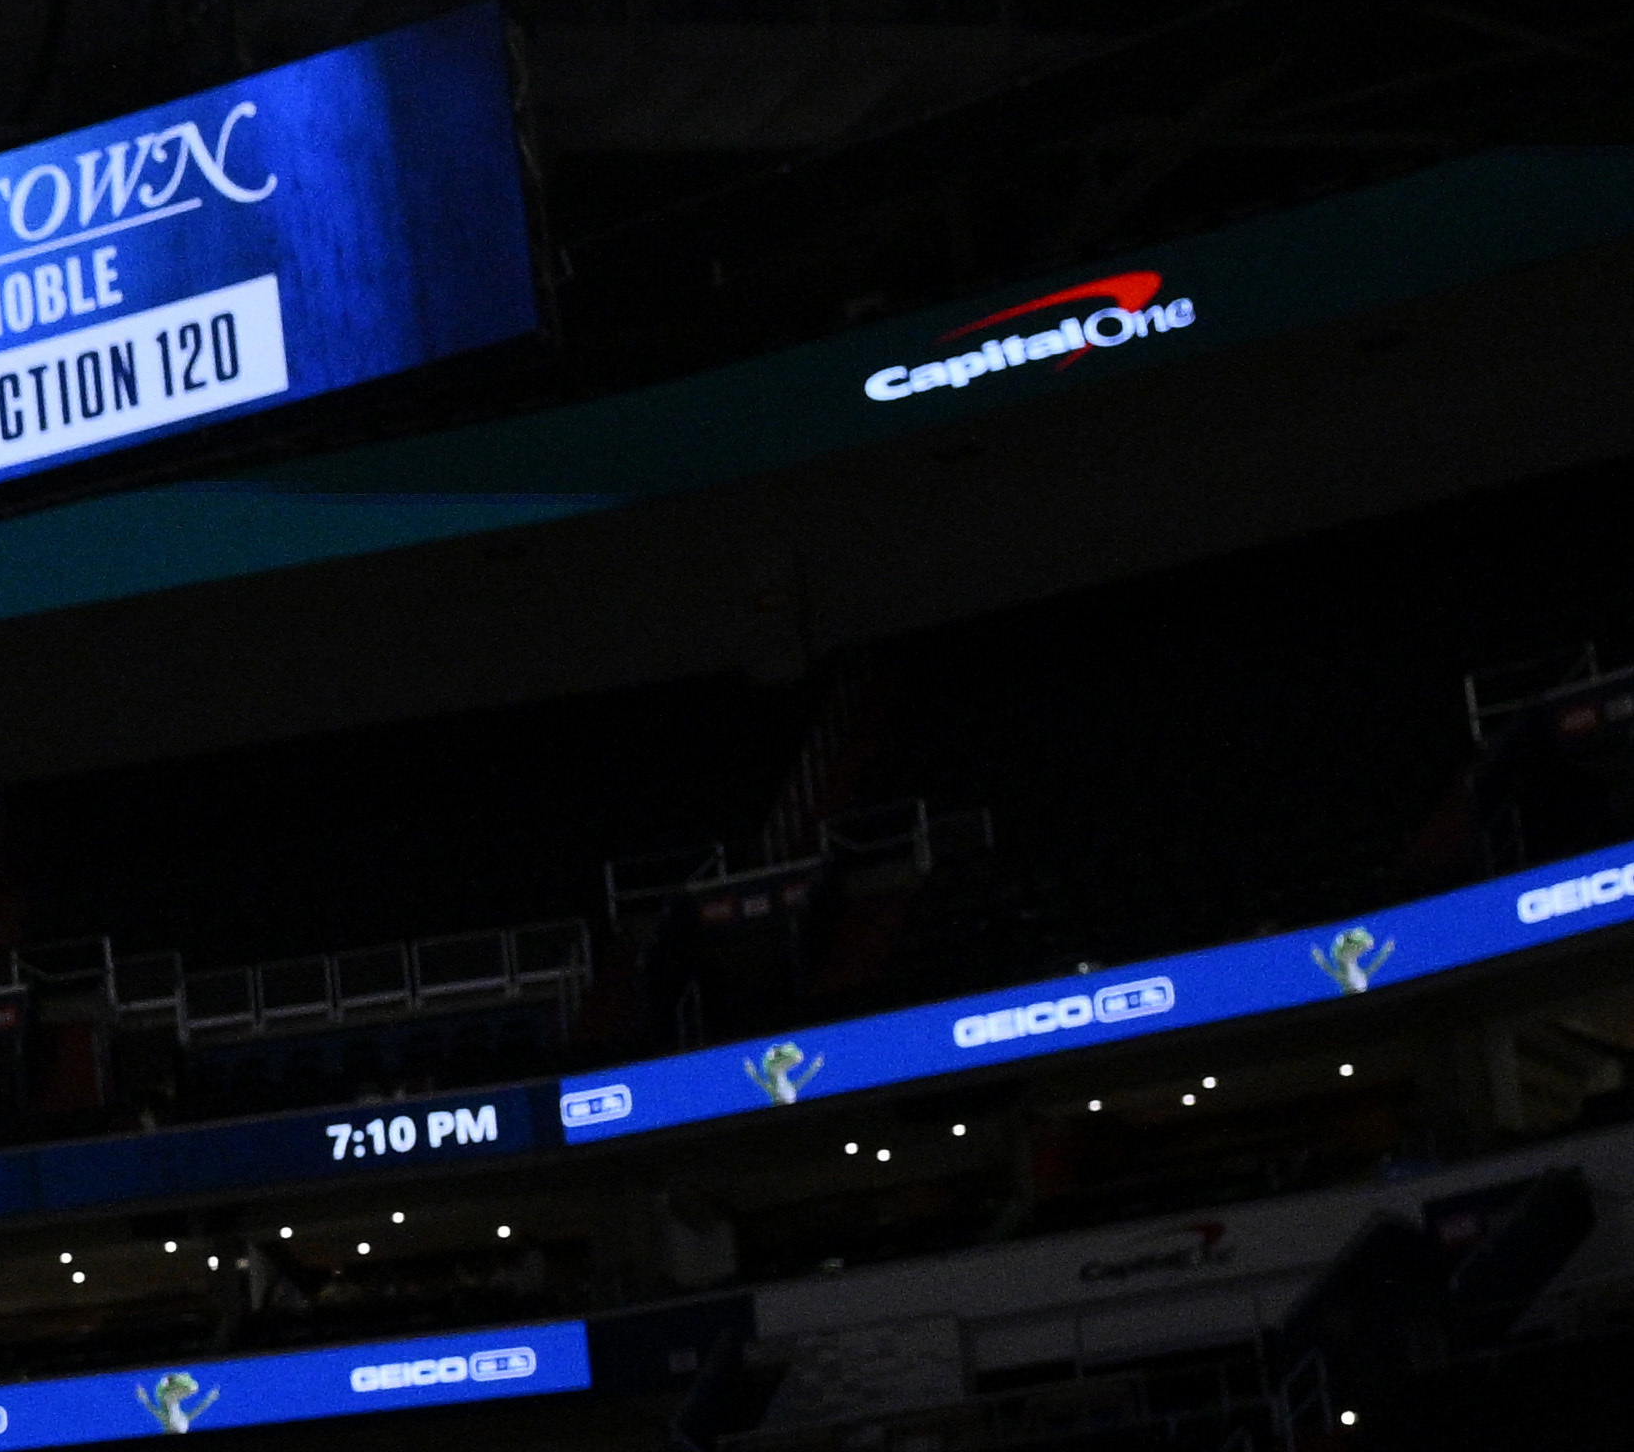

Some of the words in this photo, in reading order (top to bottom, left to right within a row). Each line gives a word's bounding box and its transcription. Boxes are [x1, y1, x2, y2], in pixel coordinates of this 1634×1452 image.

[158, 312, 241, 399] 120
[952, 994, 1093, 1048] GEICO
[326, 1114, 417, 1160] 7:10
[428, 1104, 498, 1148] PM
[350, 1355, 468, 1393] GEICO
